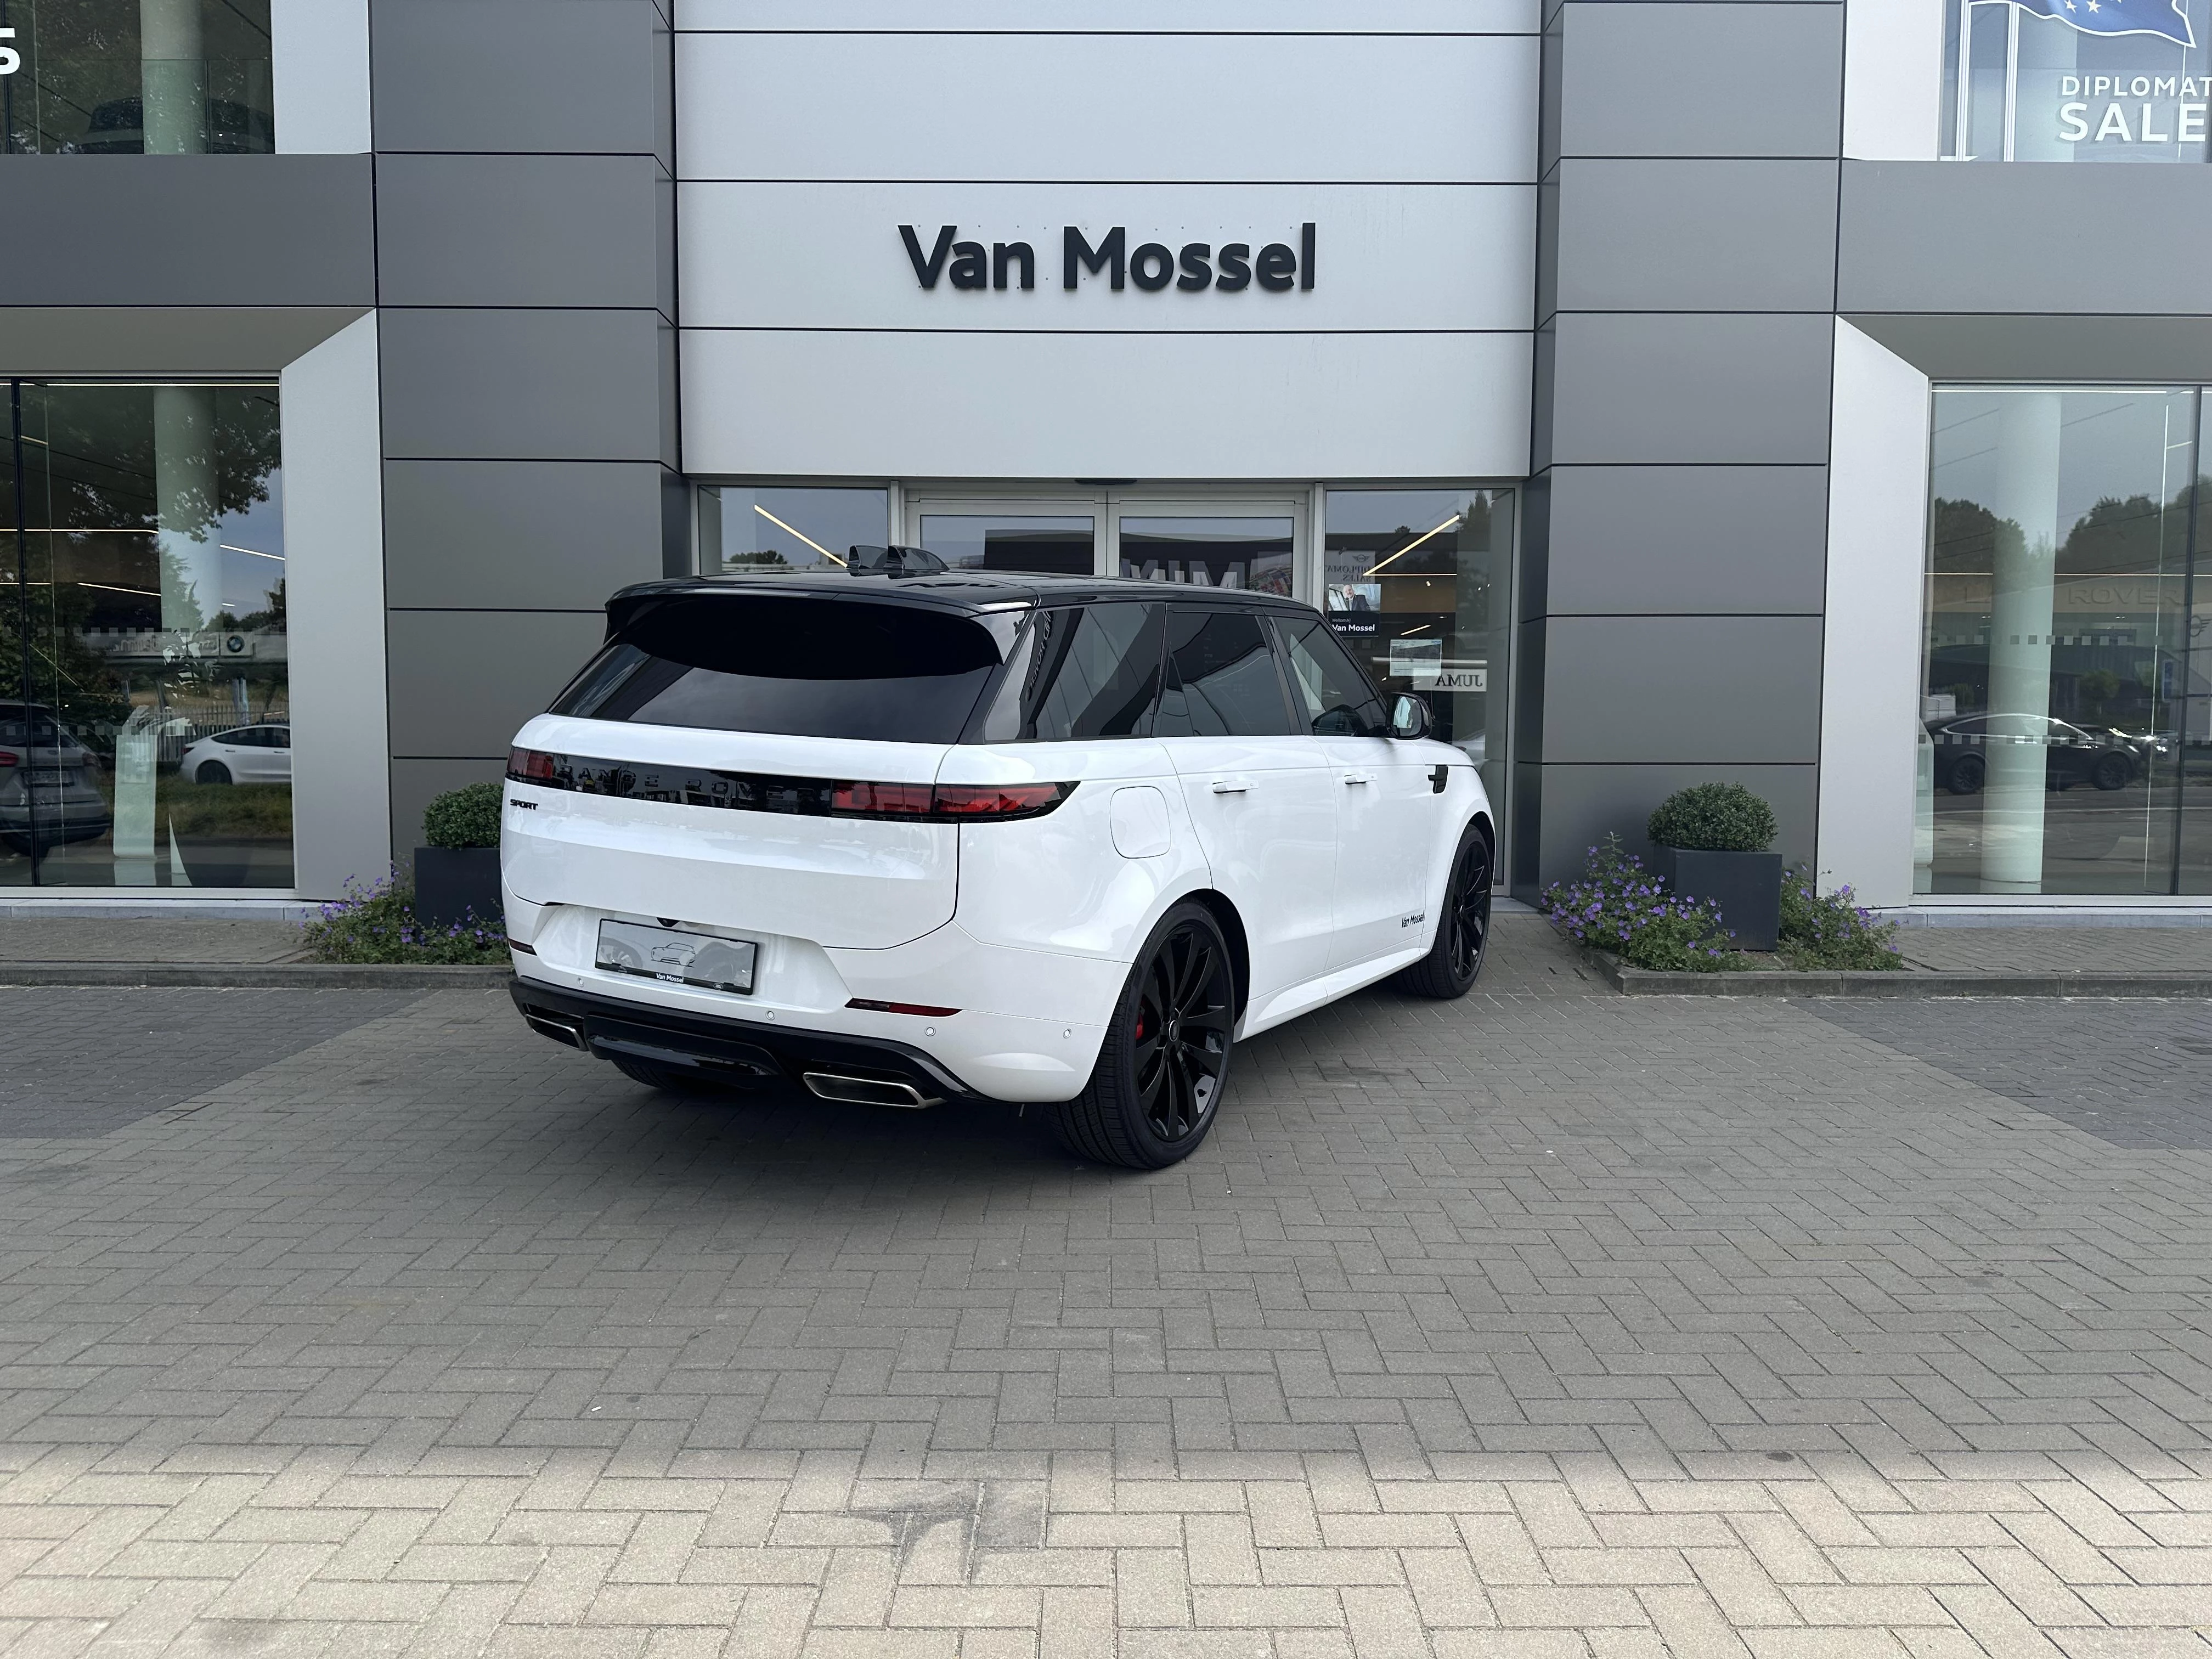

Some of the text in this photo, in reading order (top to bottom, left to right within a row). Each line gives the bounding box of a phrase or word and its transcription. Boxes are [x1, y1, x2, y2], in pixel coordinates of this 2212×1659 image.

[2062, 75, 2212, 97] DIPLOMAT
[2058, 101, 2207, 142] SALE
[897, 222, 1317, 291] Van Mossel
[1332, 624, 1375, 632] Van Mossel
[510, 798, 539, 811] SPORT
[1401, 910, 1425, 928] Van Mossel
